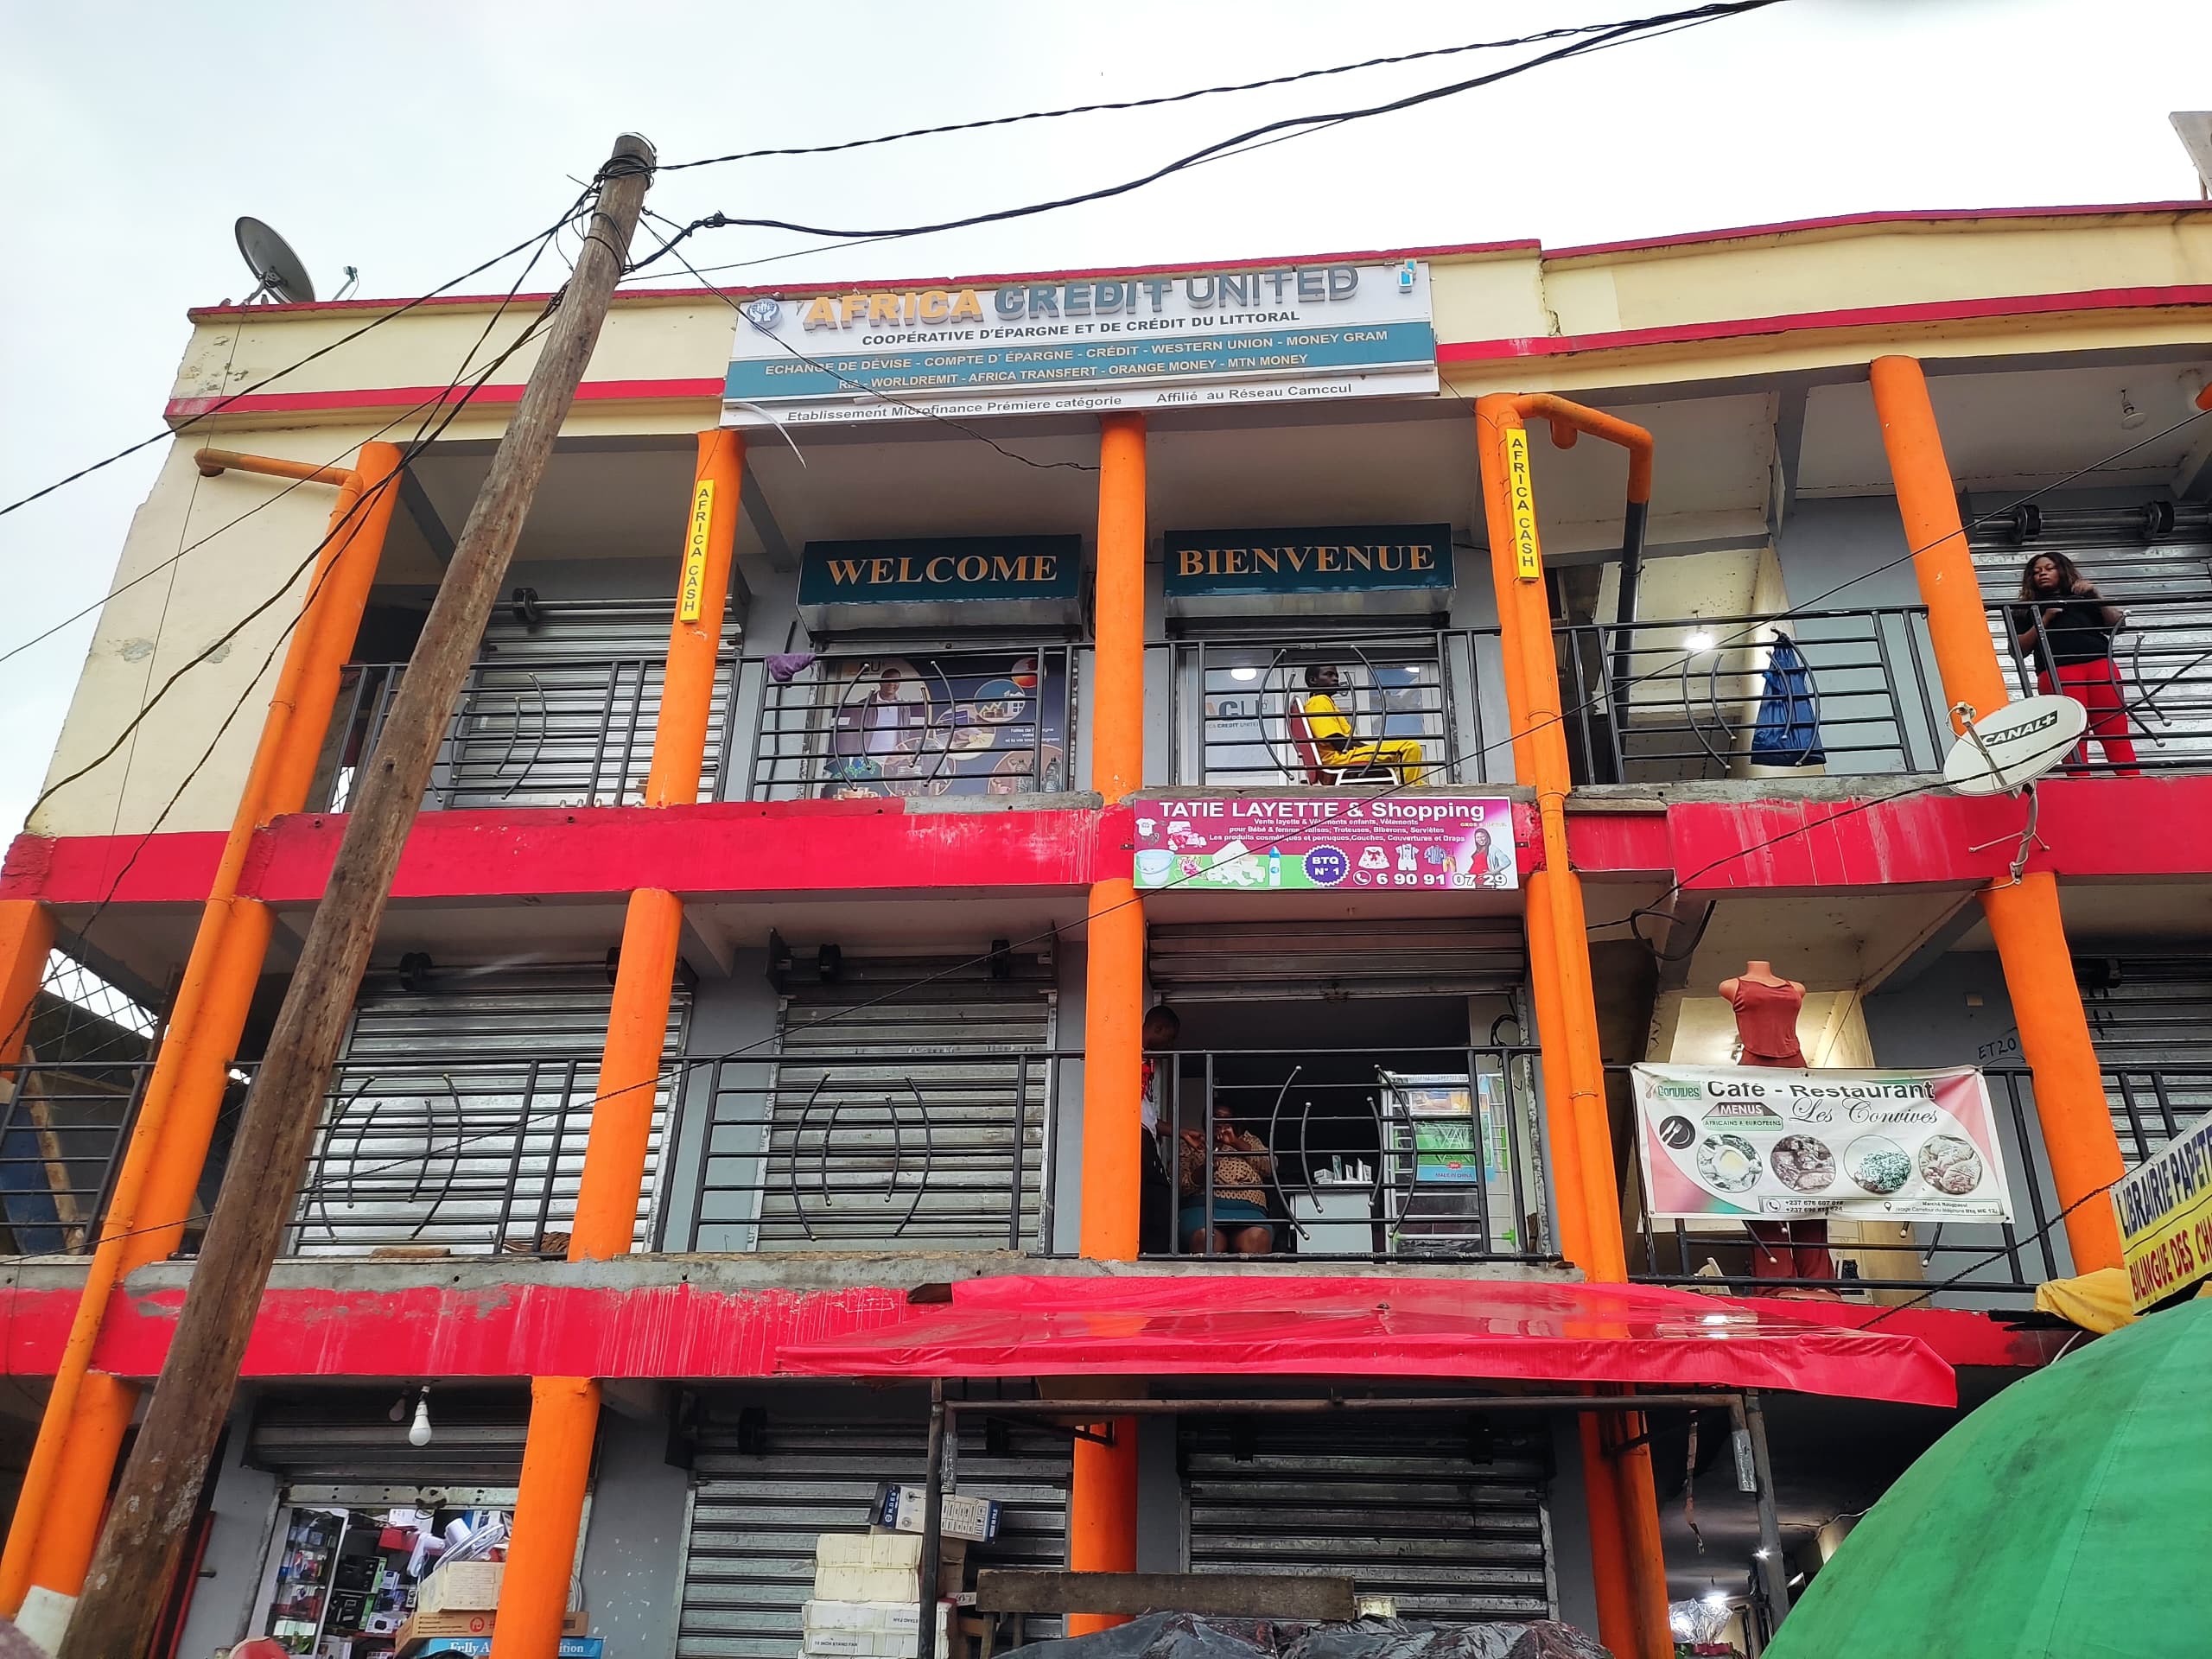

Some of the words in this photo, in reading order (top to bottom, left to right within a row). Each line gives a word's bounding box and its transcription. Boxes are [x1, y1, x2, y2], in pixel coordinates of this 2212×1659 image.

[804, 289, 984, 329] AFRICA
[995, 278, 1173, 322] CREDIT
[1185, 265, 1360, 308] UNITED
[861, 329, 974, 346] COOPÉRATIVE
[979, 324, 1069, 340] D'ÉPARGNE
[1074, 323, 1095, 334] ET
[1100, 321, 1122, 333] DE
[1126, 316, 1185, 331] CRÉDIT
[1192, 315, 1214, 327] DU
[1219, 311, 1300, 326] LITTORAL
[765, 361, 833, 375] ECHANGE
[838, 359, 857, 372] DE
[861, 356, 912, 371] DÉVISE
[925, 353, 984, 367] COMPTE
[1005, 348, 1073, 363] ÉPARGNE
[1085, 344, 1138, 359] CRÉDIT
[1151, 340, 1223, 354] WESTERN
[1227, 338, 1273, 350] UNION
[1287, 334, 1339, 346] MONEY
[1344, 330, 1388, 342] GRAM
[871, 373, 958, 388] WORLDREMIT
[969, 370, 1016, 384] AFRICA
[1020, 365, 1097, 380] TRANSFERT
[1109, 361, 1166, 375] ORANGE
[1168, 359, 1217, 372] MONEY
[1227, 355, 1257, 367] MTN
[1260, 353, 1308, 365] MONEY
[787, 406, 889, 422] Etablissement
[891, 401, 985, 418] Microfinance
[987, 396, 1052, 411] Prémiere
[1055, 394, 1122, 410] catégorie
[1156, 390, 1198, 404] Affilié
[1206, 391, 1224, 402] au
[1229, 385, 1282, 400] Réseau
[1287, 383, 1352, 397] Camccul
[1512, 437, 1529, 512] AFRICA
[690, 488, 709, 558] AFRICA
[1176, 544, 1435, 576] BIENVENUE
[1518, 518, 1535, 568] CASH
[826, 553, 1058, 586] WELCOME
[683, 564, 699, 612] CASH
[1982, 711, 2058, 747] CANAL+
[1159, 802, 1224, 817] TATIE
[1232, 802, 1339, 817] LAYETTE
[1347, 802, 1364, 818] &
[1371, 802, 1485, 822] Shopping
[1312, 855, 1339, 866] BTQ
[1333, 867, 1340, 875] 1
[1376, 873, 1389, 886] 6
[1393, 873, 1418, 886] 90
[1423, 873, 1446, 886] 91
[1452, 873, 1475, 886] 07
[1483, 873, 1507, 886] 29
[1707, 1080, 1765, 1097] Café
[1791, 1080, 1936, 1100] Restaurant
[1720, 1104, 1762, 1115] MENUS
[1789, 1096, 1834, 1124] Les
[1841, 1096, 1938, 1125] Convives
[2115, 1158, 2174, 1240] LIBRAIRIE
[2128, 1243, 2175, 1302] BILINGUE
[2169, 1229, 2196, 1279] DES
